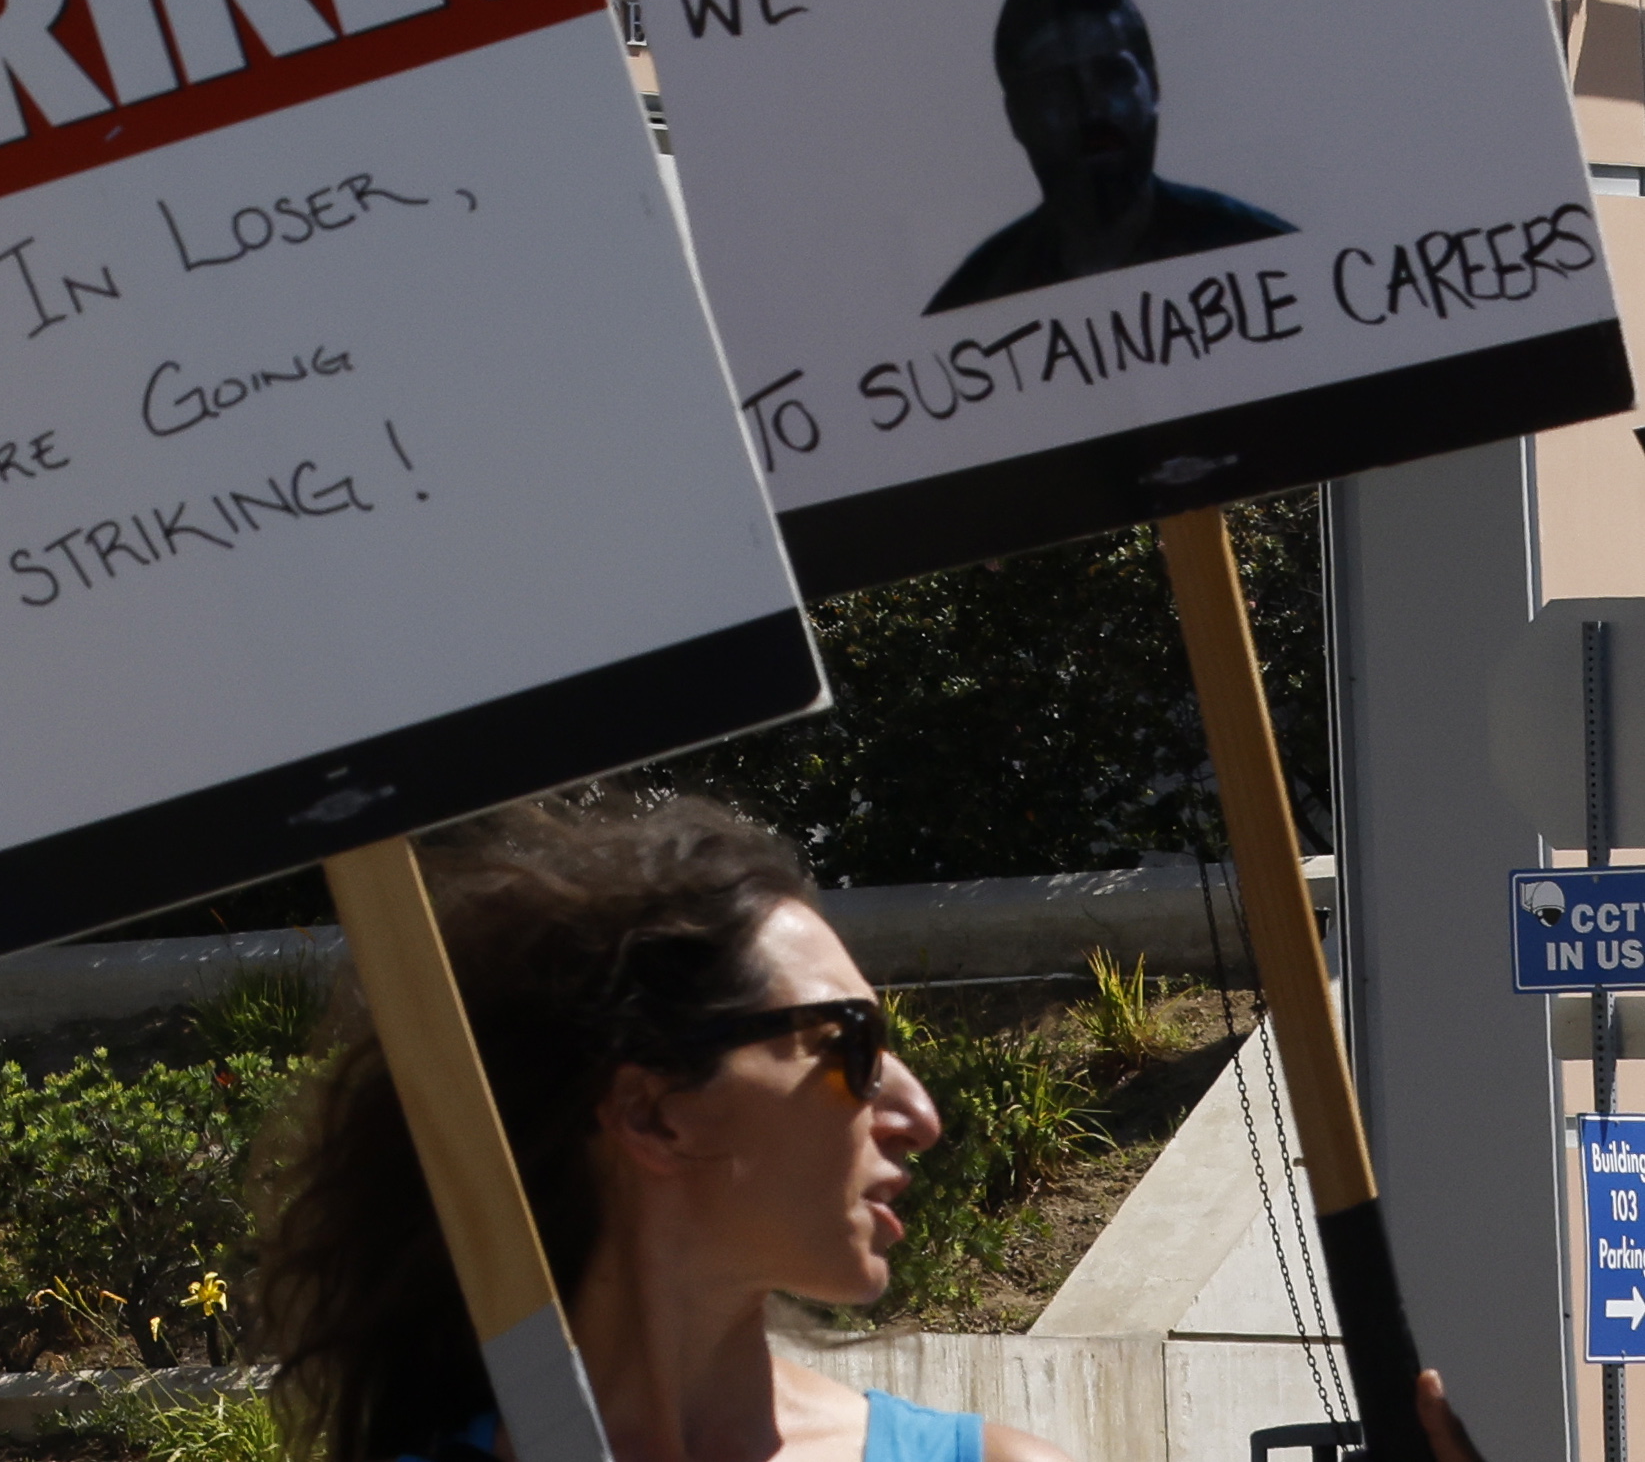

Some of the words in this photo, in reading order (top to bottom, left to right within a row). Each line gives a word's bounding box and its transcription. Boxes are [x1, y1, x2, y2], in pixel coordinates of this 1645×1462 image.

[740, 370, 820, 471] TO
[858, 269, 1301, 432] SUSTAINABLE
[1333, 204, 1596, 326] CAREERS
[1571, 902, 1645, 933] CCT
[1546, 940, 1583, 971] IN
[1597, 939, 1645, 970] US
[1610, 1190, 1638, 1222] 103
